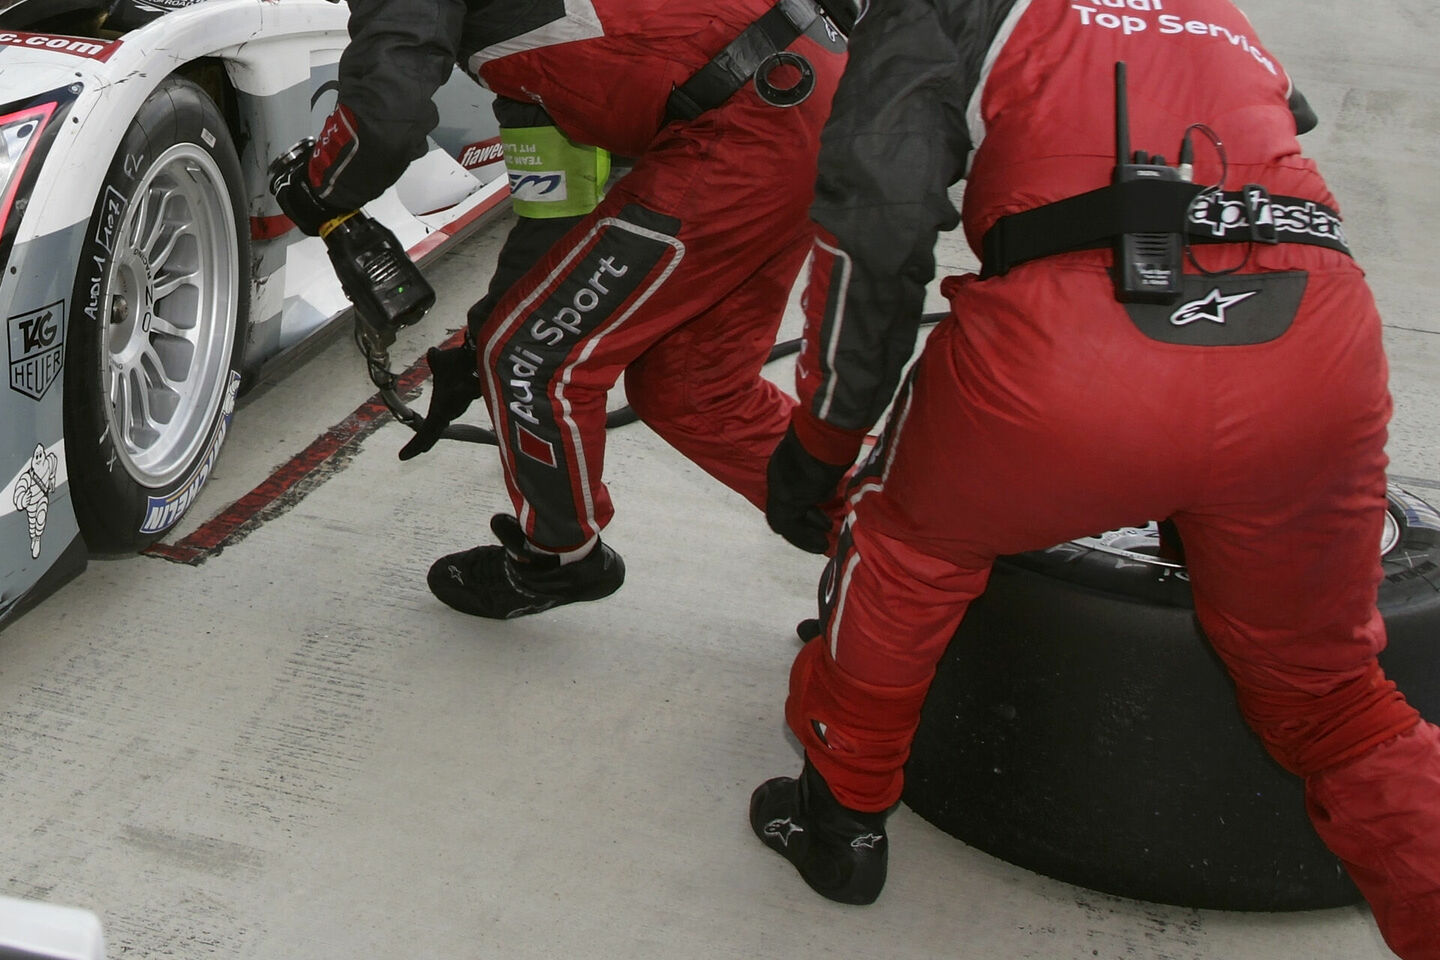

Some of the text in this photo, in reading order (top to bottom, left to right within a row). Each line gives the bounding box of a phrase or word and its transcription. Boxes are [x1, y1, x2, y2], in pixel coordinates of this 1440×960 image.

[1071, 5, 1277, 76] Top Service
[84, 276, 102, 320] AUDI
[18, 310, 57, 353] TAG
[510, 254, 628, 425] Audi Sport
[14, 350, 61, 394] HEUER
